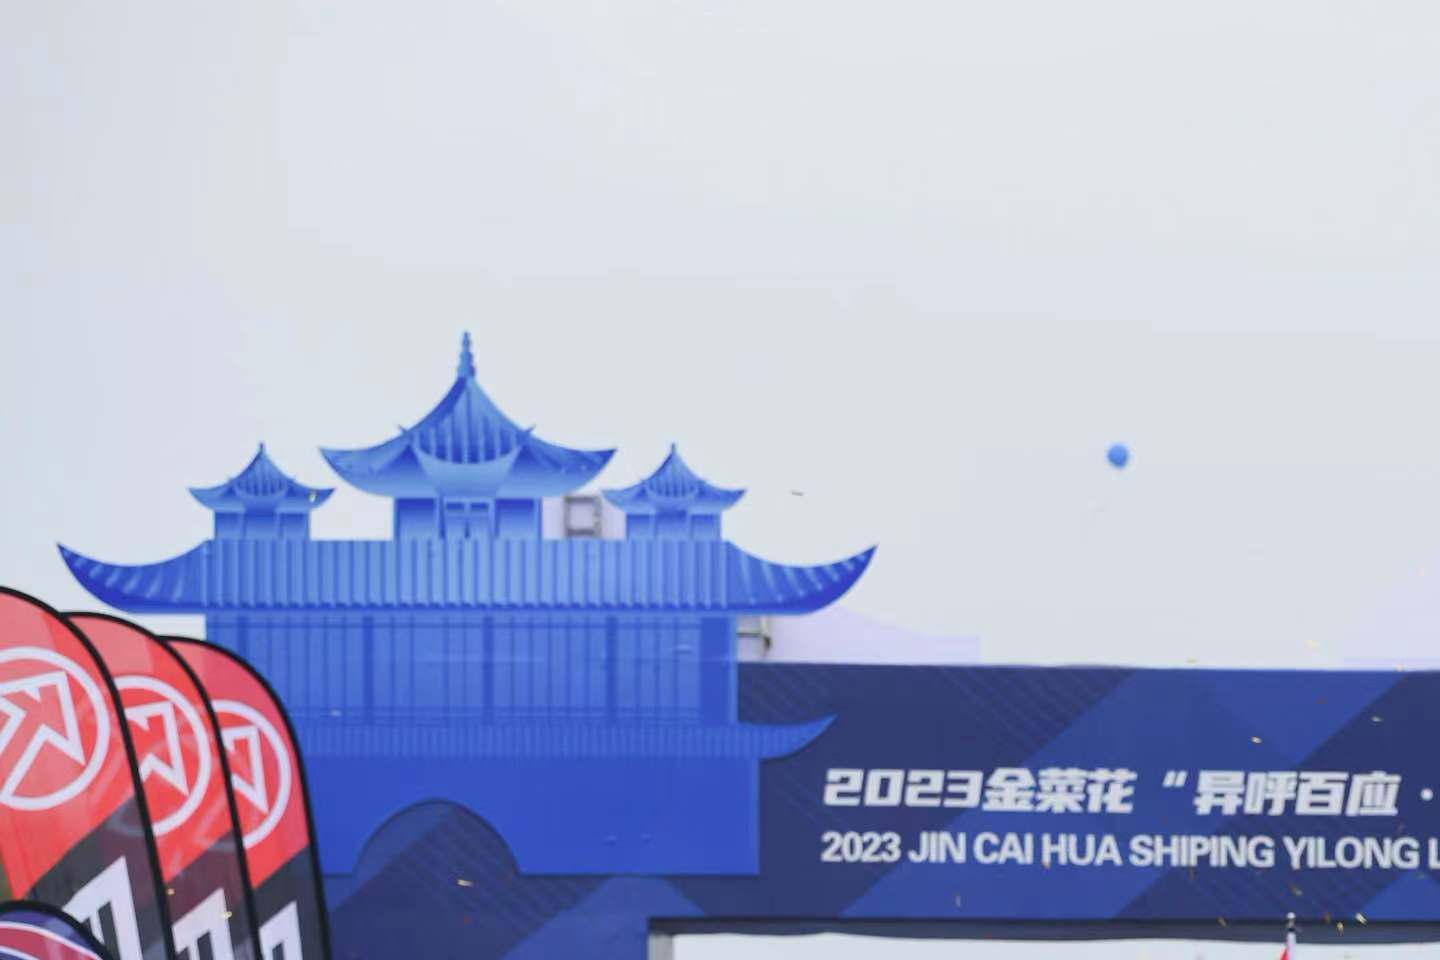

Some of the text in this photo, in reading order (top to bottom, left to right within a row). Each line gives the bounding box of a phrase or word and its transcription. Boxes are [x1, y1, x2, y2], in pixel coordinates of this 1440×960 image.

[823, 767, 1137, 814] 2023金菜花
[821, 831, 902, 863] 2023
[908, 831, 967, 864] JIN
[973, 832, 1033, 865] CAI
[1041, 833, 1123, 867] HUA
[1129, 834, 1275, 867] SHIPING
[1283, 835, 1420, 870] YILONG
